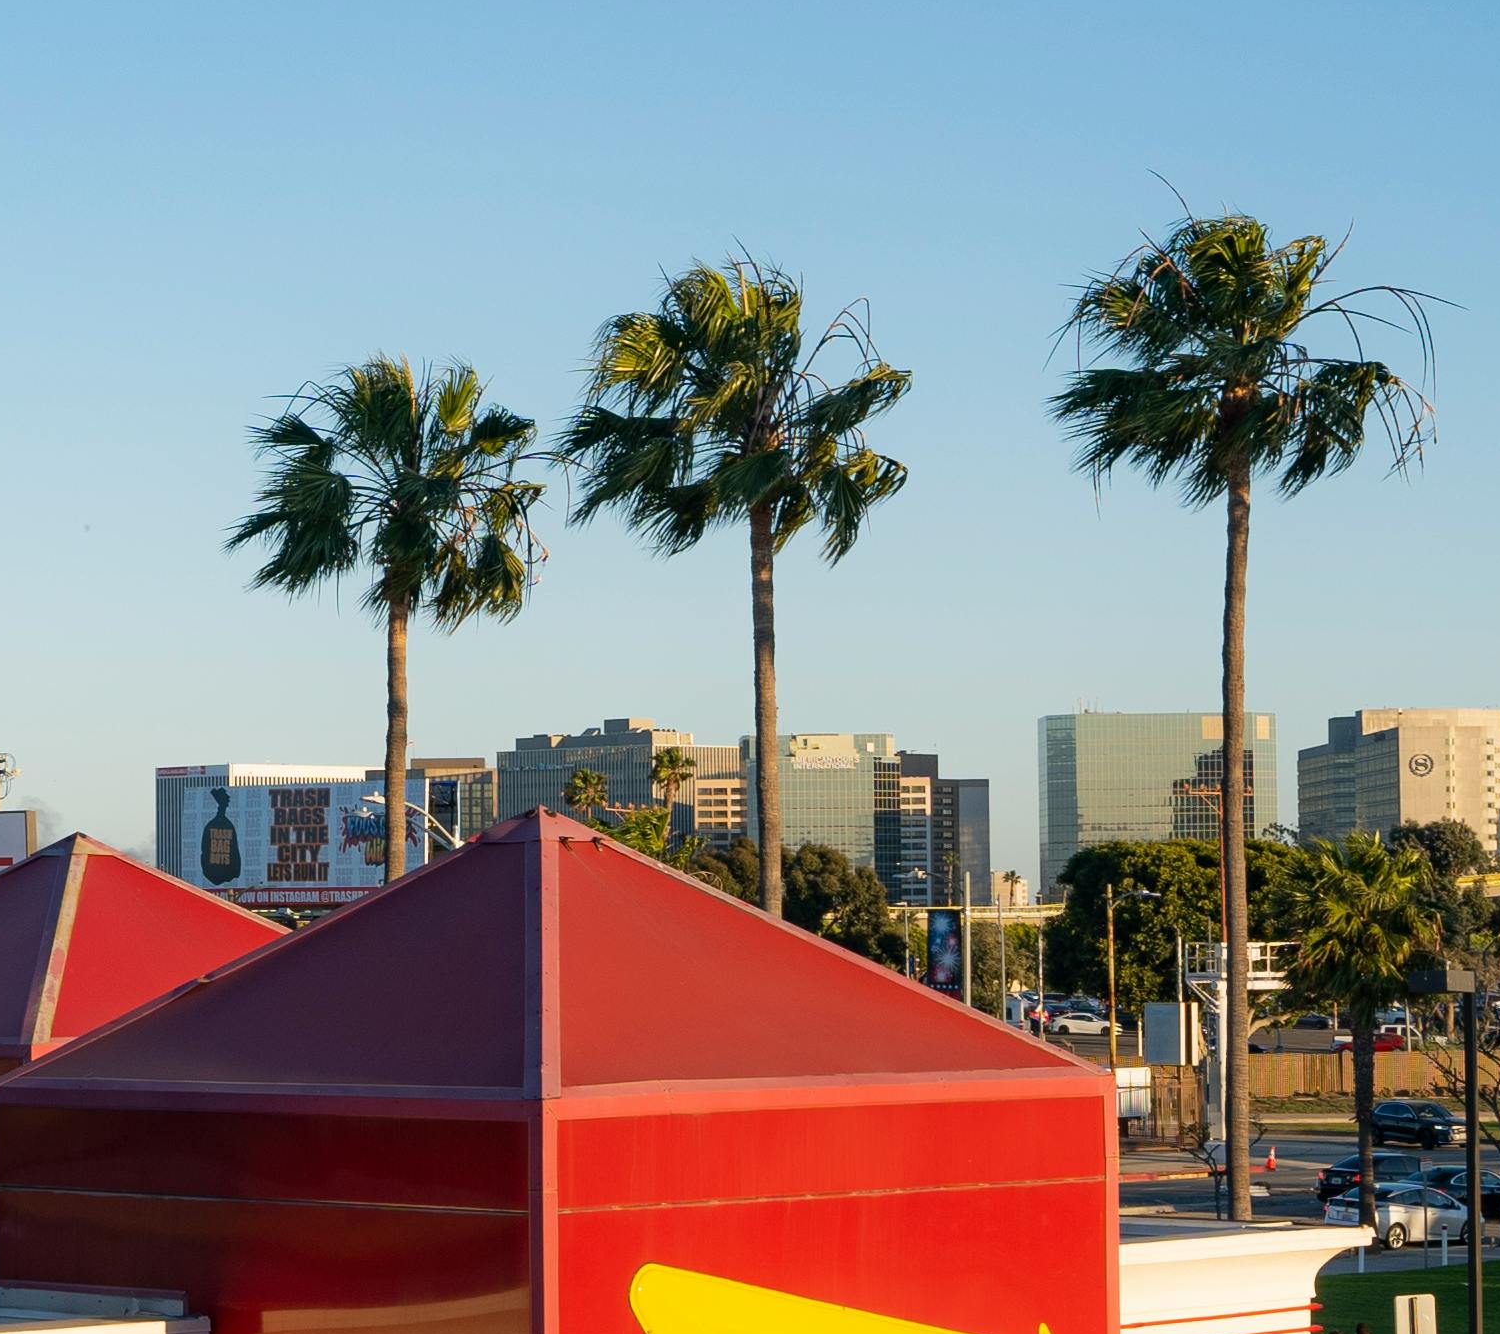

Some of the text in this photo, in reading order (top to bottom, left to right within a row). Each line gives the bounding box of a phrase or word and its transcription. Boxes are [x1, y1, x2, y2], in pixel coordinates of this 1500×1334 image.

[268, 788, 330, 808] TRASH
[274, 807, 325, 826] BAGS
[270, 825, 292, 845] IN
[294, 825, 329, 844] THE
[211, 840, 231, 853] BAG
[277, 845, 321, 864] CITY
[267, 863, 330, 882] LETS RUN IT
[256, 891, 268, 903] ON
[270, 891, 319, 903] INSTAGRAM
